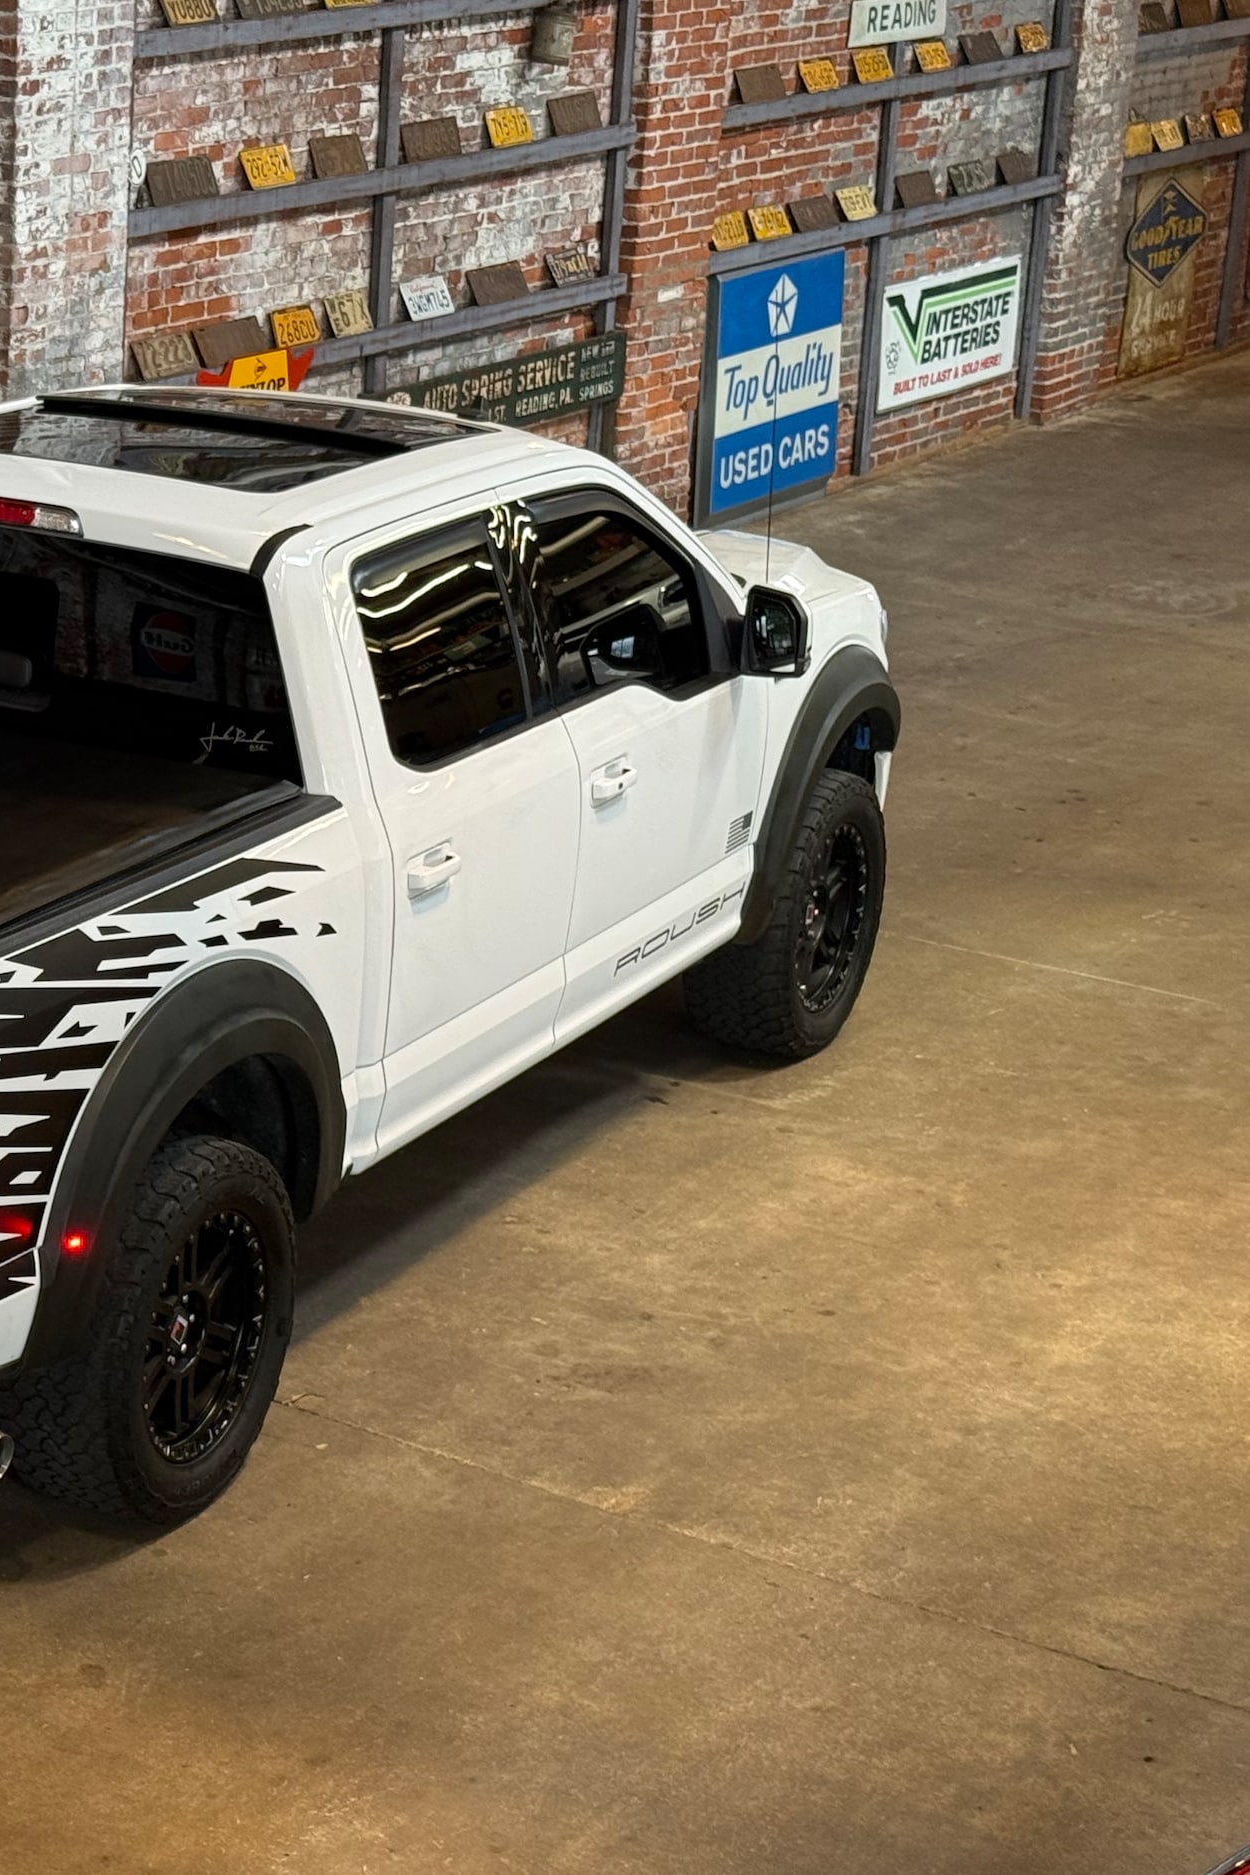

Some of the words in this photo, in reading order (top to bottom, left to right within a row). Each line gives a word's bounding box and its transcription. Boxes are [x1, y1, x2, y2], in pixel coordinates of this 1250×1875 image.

[867, 1, 936, 33] READING
[1131, 215, 1204, 250] GOODYEAR
[1147, 246, 1181, 270] TIRES
[925, 291, 1012, 337] INTERSTATE
[1153, 297, 1186, 323] HOUR
[278, 320, 317, 345] 268CU
[920, 321, 1001, 365] BATTERIES
[423, 383, 458, 411] AUTO
[461, 368, 513, 406] SPRING
[517, 351, 576, 393] SERVICE
[579, 379, 614, 402] SPRINGS
[724, 364, 759, 421] Top
[762, 342, 834, 408] Quality
[893, 378, 917, 396] BUILT
[918, 375, 930, 389] TO
[930, 368, 953, 385] LAST
[961, 361, 980, 377] SOLD
[719, 443, 774, 489] USED
[778, 424, 830, 470] CARS
[613, 881, 746, 978] ROUSH
